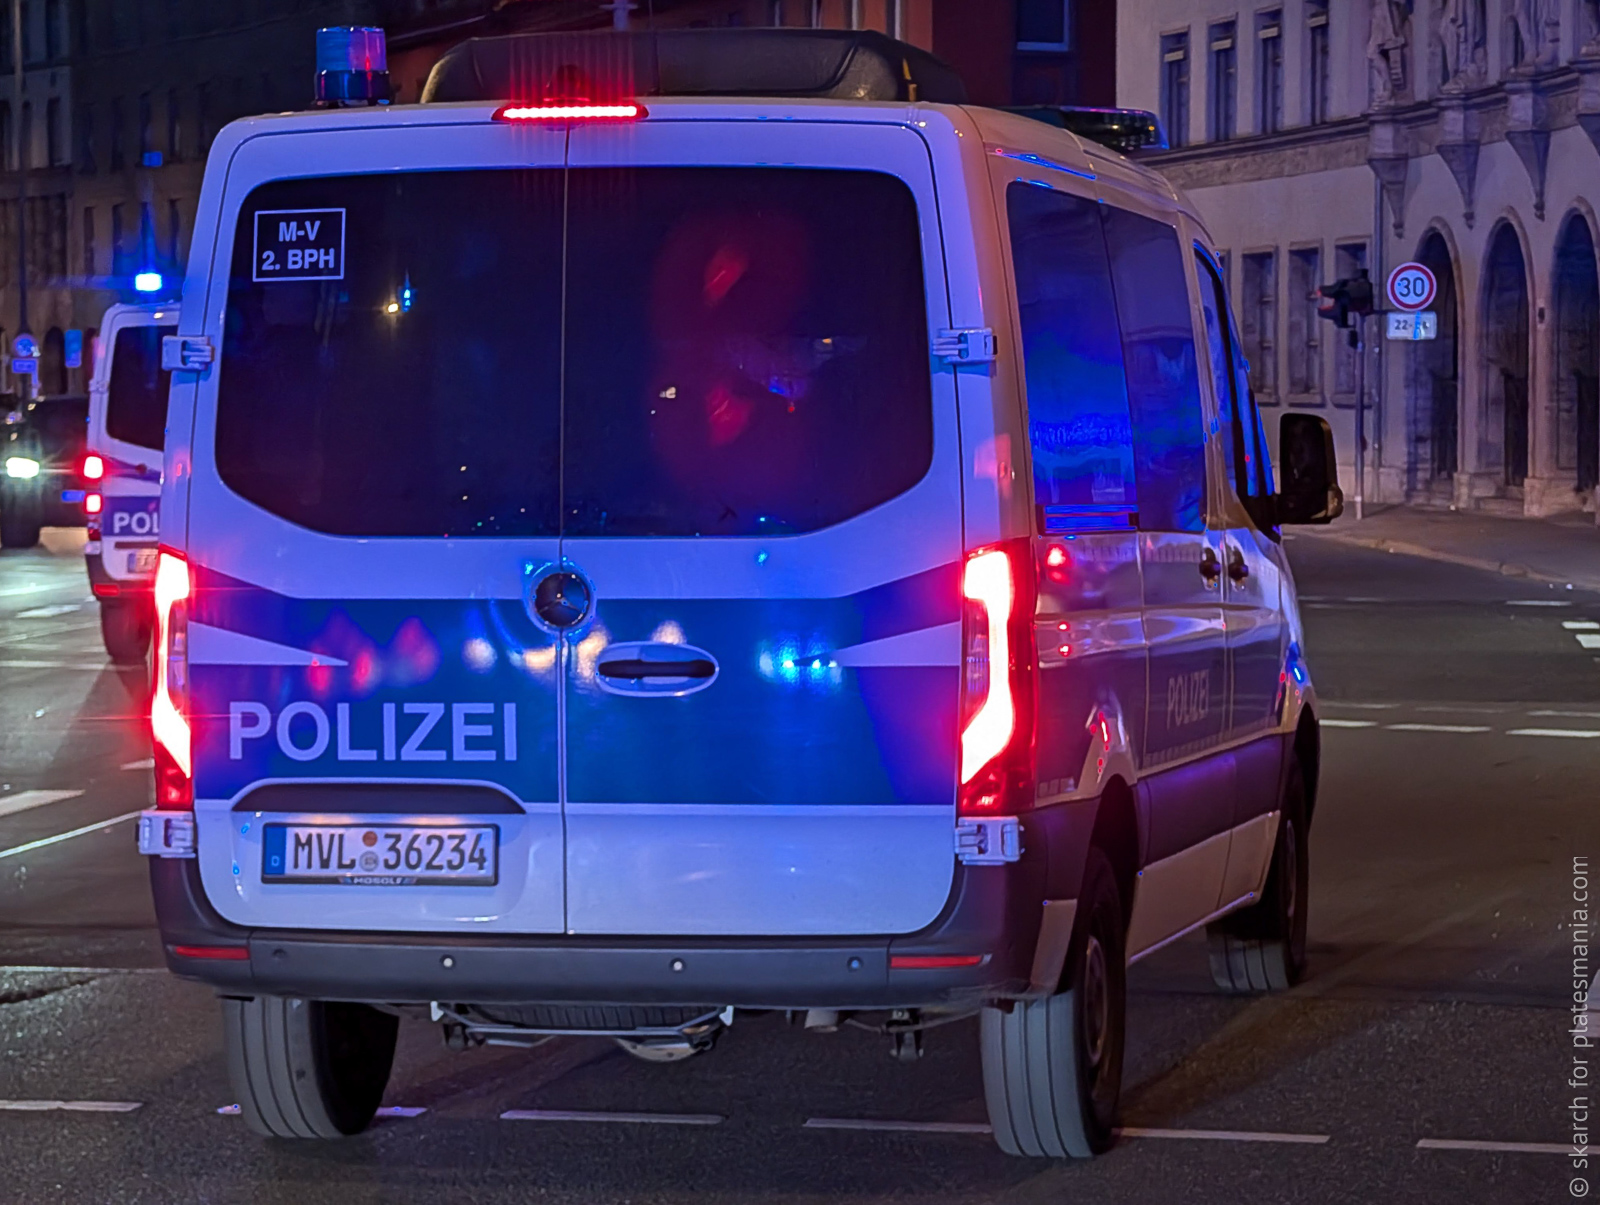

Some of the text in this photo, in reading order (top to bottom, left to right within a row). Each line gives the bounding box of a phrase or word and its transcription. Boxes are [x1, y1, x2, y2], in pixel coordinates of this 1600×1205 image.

[279, 220, 321, 242] M-V
[261, 248, 335, 270] 2. BPH
[1399, 277, 1425, 297] 30
[1166, 669, 1210, 731] POLIZEI
[229, 701, 517, 761] POLIZEI
[271, 832, 487, 871] D MVL 36234
